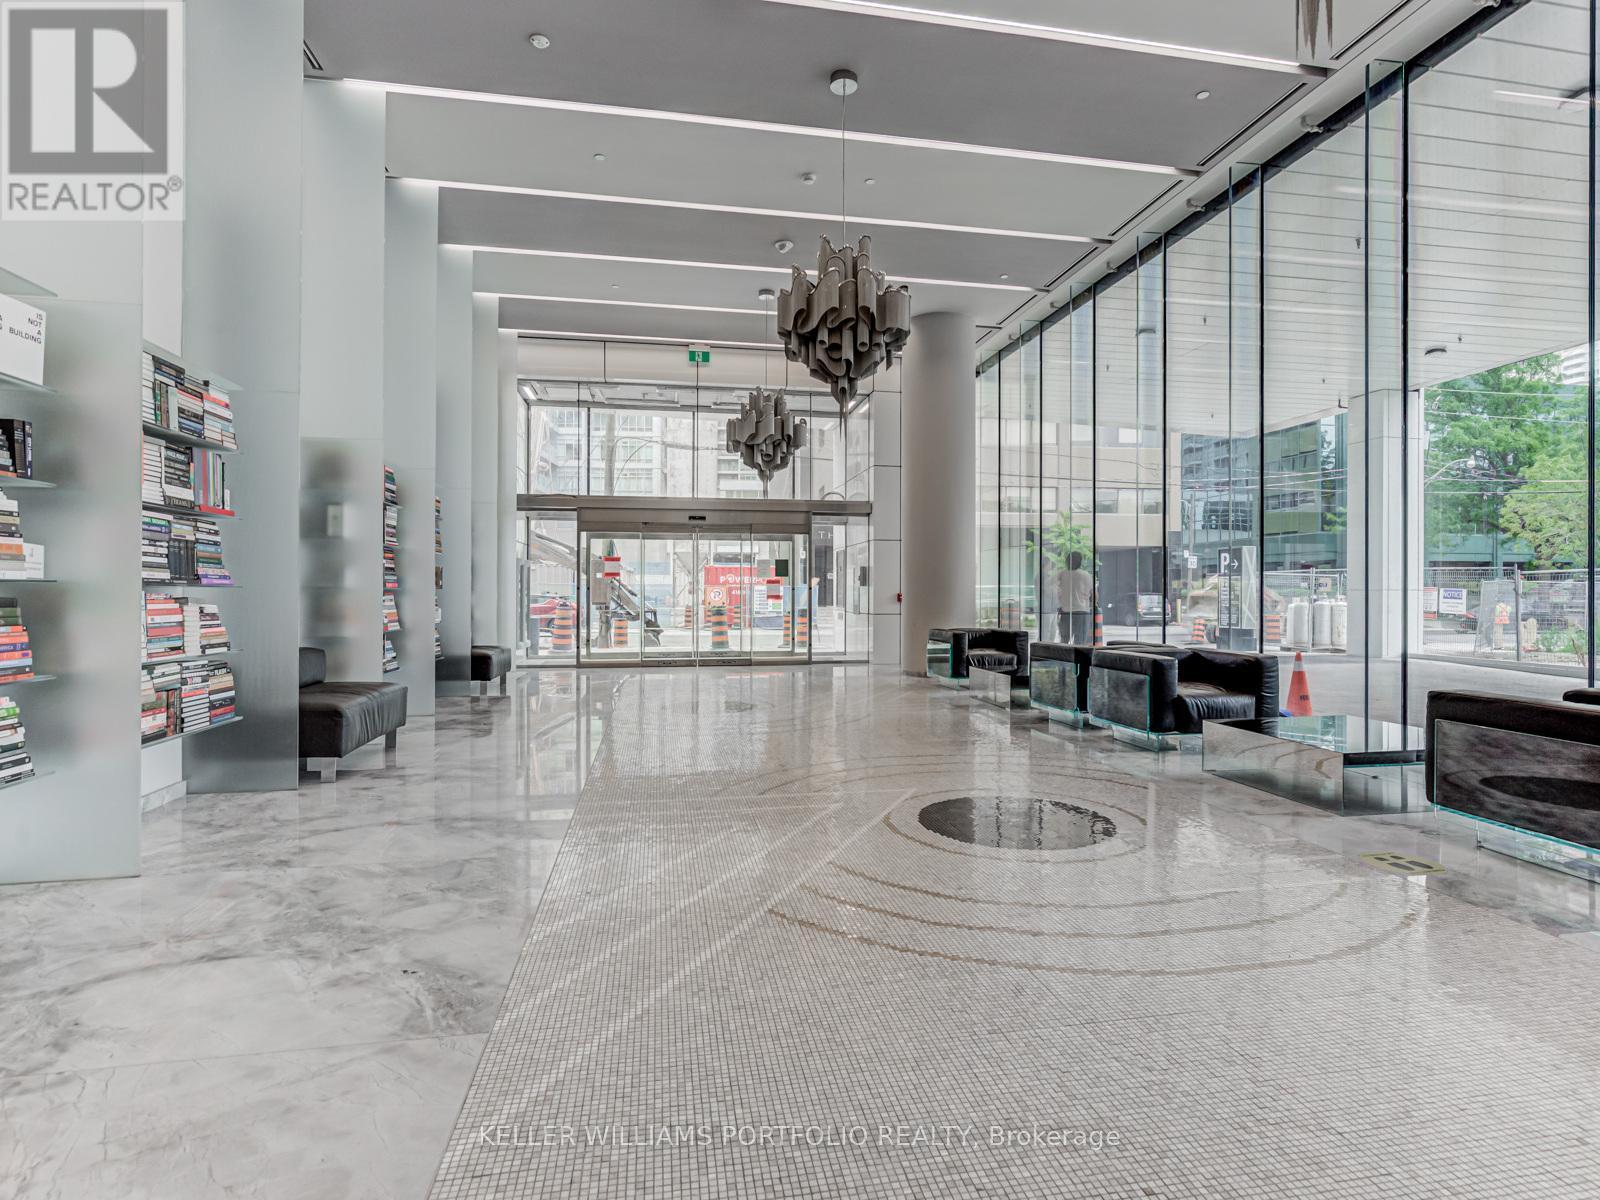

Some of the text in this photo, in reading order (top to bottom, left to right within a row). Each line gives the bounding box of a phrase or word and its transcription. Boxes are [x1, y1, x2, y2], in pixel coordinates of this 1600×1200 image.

[28, 317, 42, 327] NOT
[36, 313, 43, 321] IS
[9, 327, 42, 344] BUILDING
